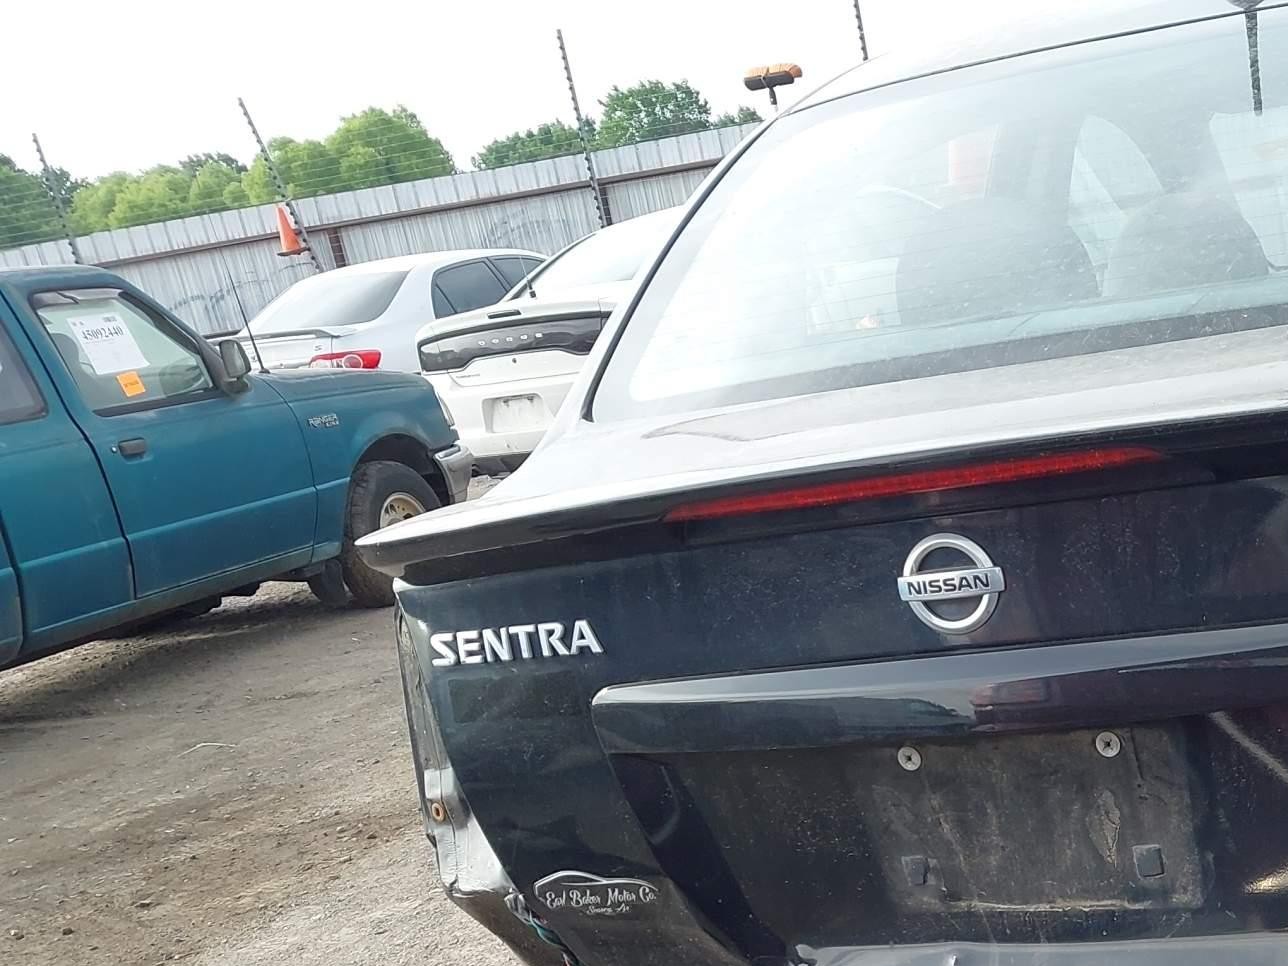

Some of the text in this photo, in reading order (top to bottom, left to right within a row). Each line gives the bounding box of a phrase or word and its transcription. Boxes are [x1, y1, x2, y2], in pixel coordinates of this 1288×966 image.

[906, 572, 990, 595] NISSAN
[430, 619, 604, 667] SENTRA
[606, 887, 636, 906] Motor
